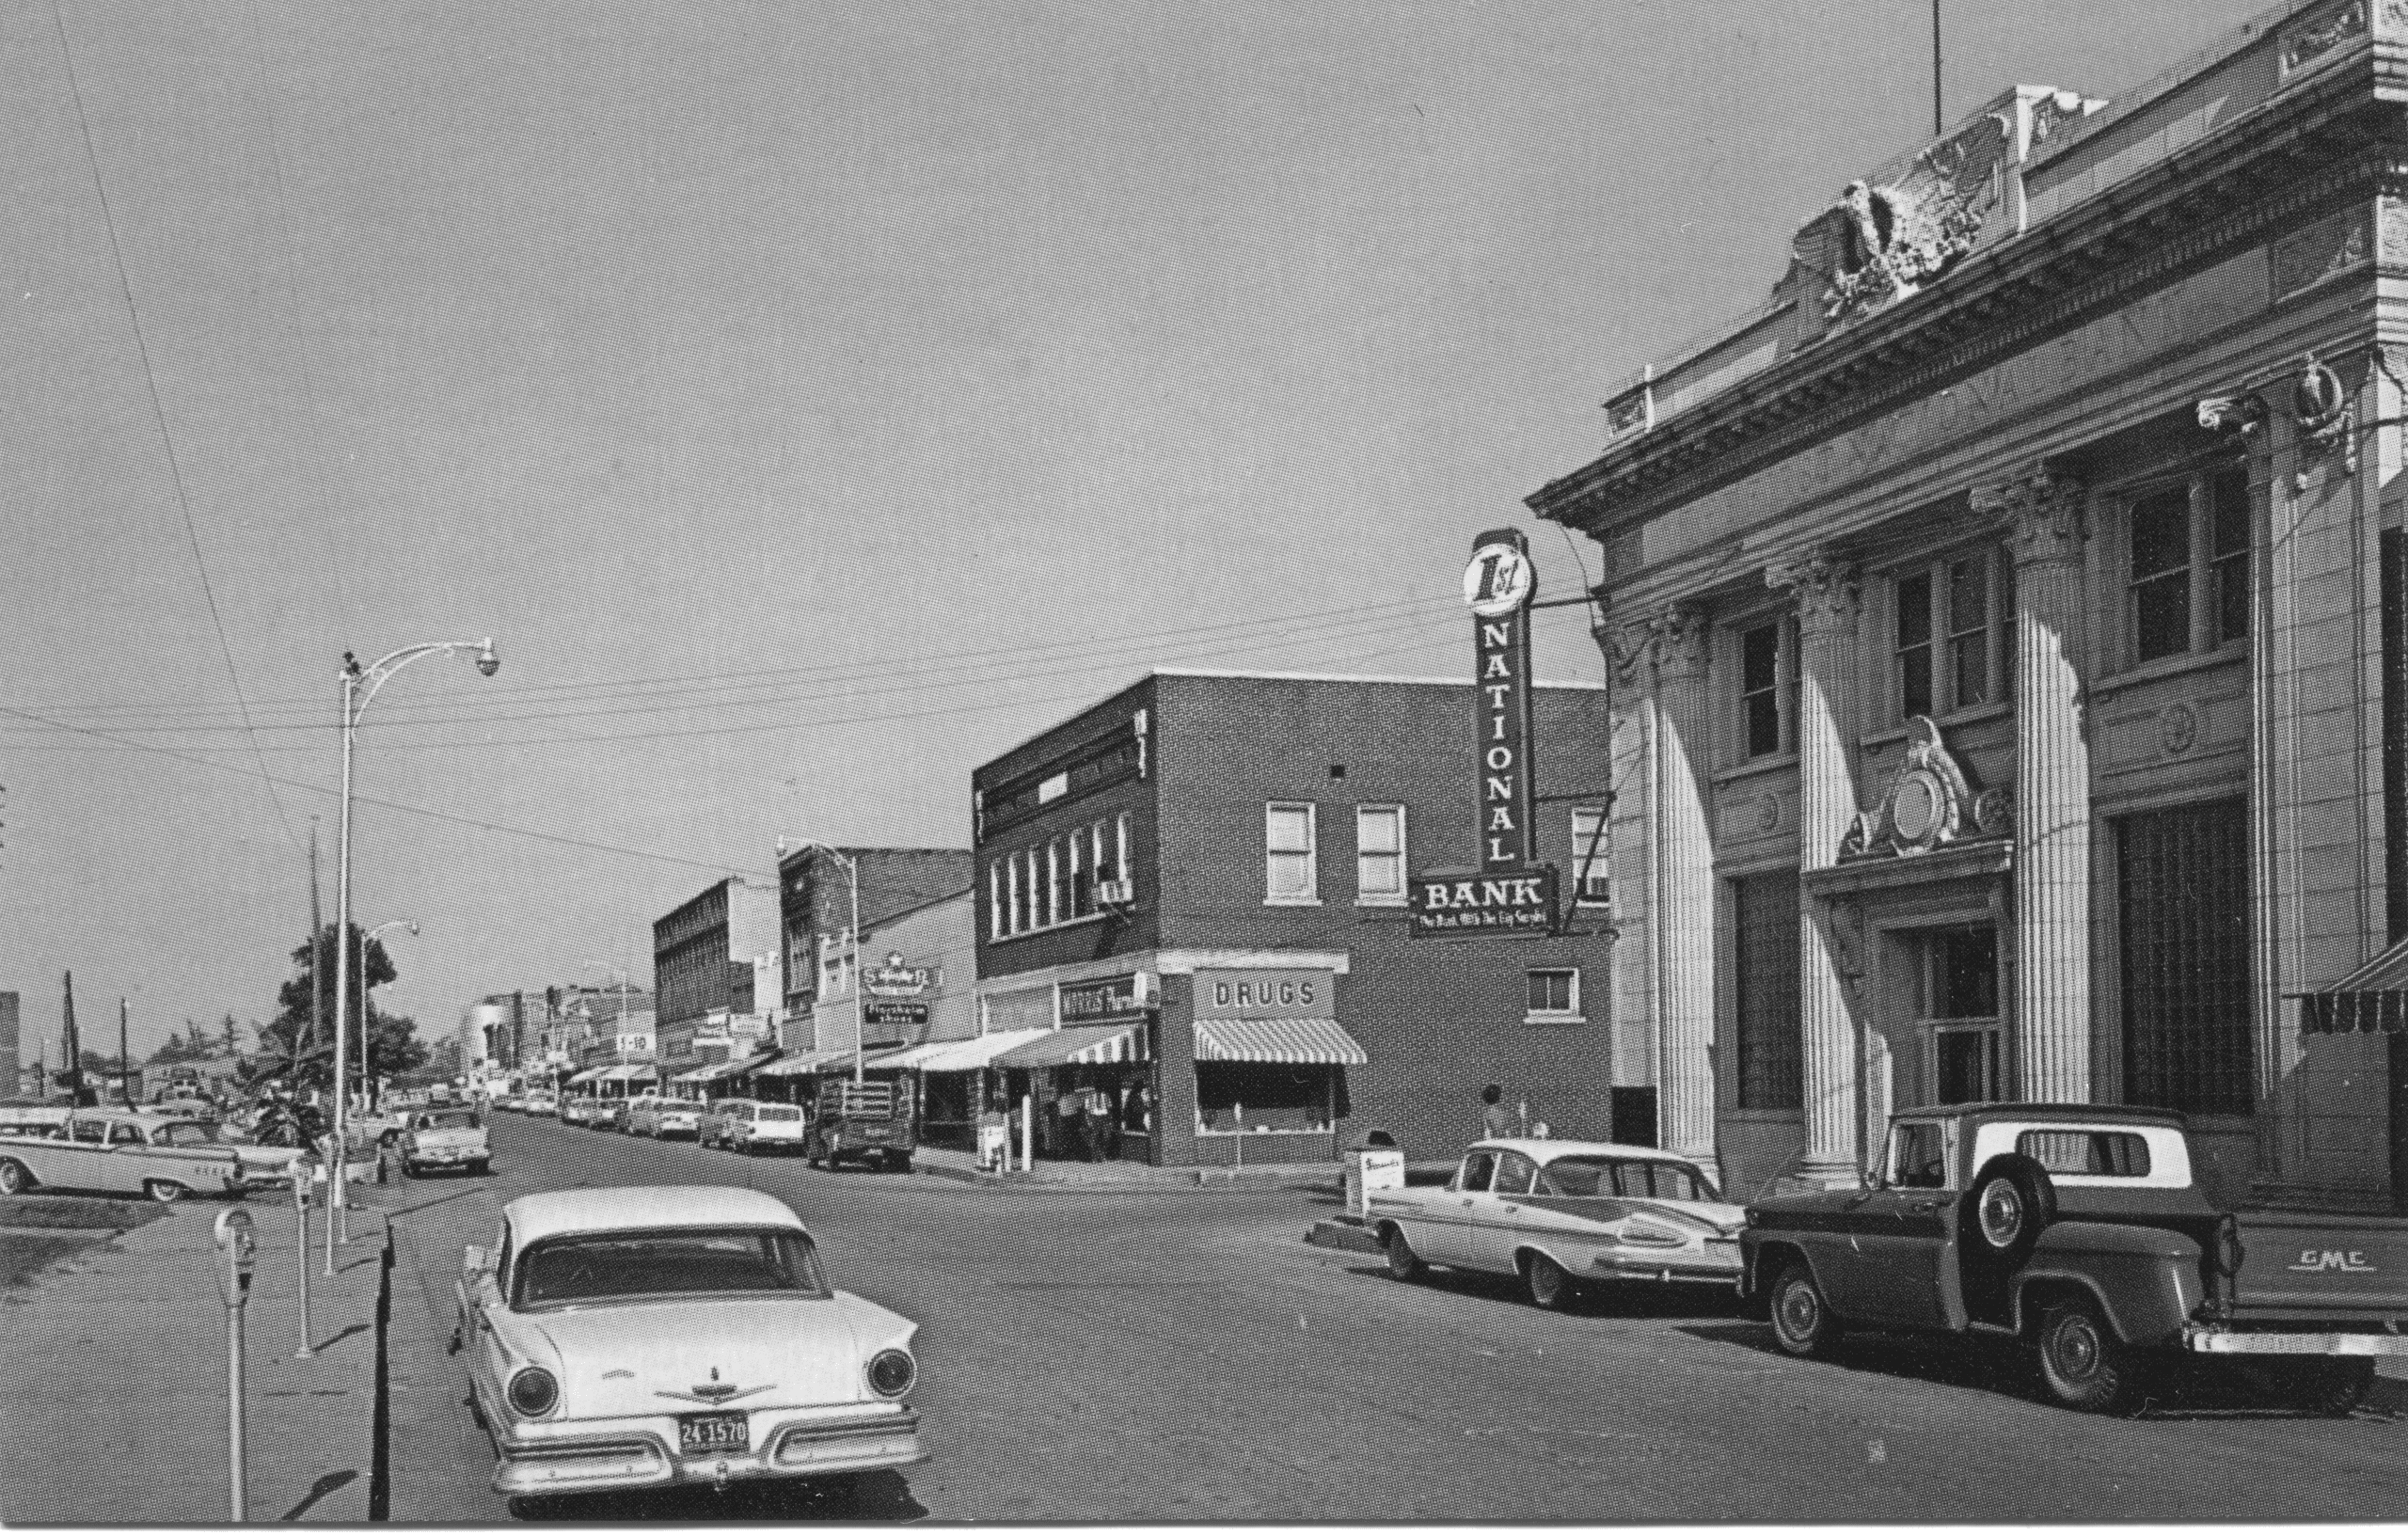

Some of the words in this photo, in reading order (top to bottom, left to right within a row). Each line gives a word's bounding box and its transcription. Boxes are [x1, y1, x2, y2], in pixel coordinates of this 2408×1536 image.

[1473, 553, 1520, 601] 1st
[1483, 622, 1515, 861] NATIONAL
[1425, 878, 1544, 909] BANK
[1214, 982, 1315, 1006] DRUGS
[2299, 1250, 2367, 1270] GMC
